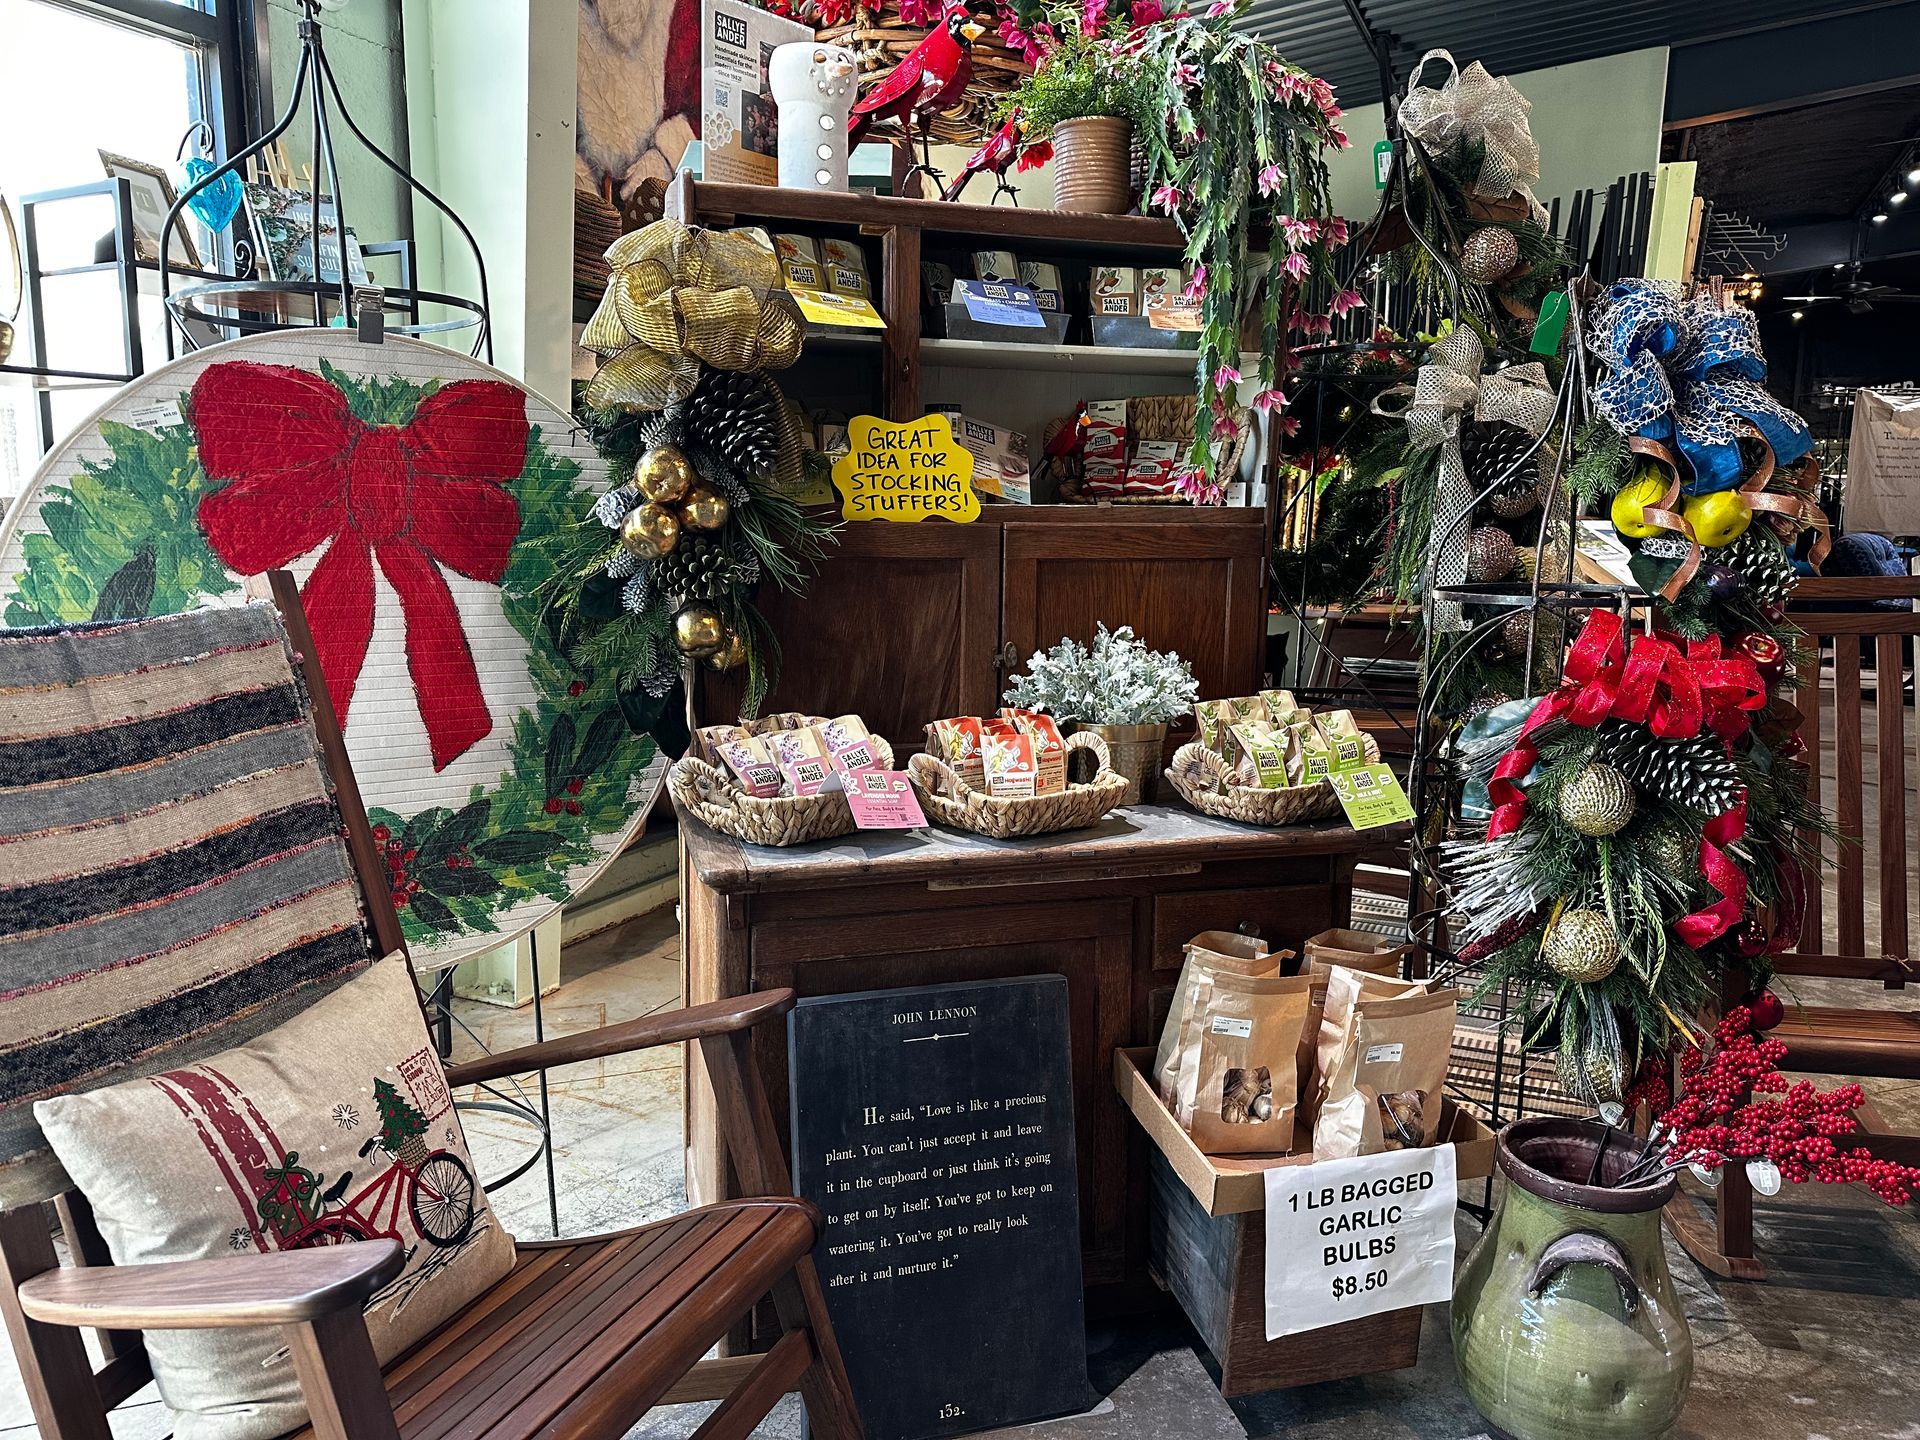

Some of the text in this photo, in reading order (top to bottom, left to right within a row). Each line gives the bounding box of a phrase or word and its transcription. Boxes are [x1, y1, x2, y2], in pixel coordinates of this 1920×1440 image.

[717, 15, 745, 34] SALLYE
[717, 27, 745, 47] ANDER
[790, 267, 814, 277] SALLYE
[836, 270, 861, 281] SALLYE
[792, 275, 816, 284] ANDER
[837, 279, 861, 289] ANDER
[1104, 304, 1128, 313] ANDER
[967, 423, 993, 435] SALLYE
[867, 426, 941, 450] GREAT
[967, 430, 994, 443] ANDER
[857, 452, 900, 470] IDEA
[909, 452, 947, 469] FOR
[850, 473, 962, 493] STOCKING
[851, 493, 969, 513] STUFFERS!
[1338, 743, 1357, 753] SALLYE
[841, 748, 867, 763] SALLYE
[1259, 752, 1277, 760] SALLYE
[1340, 751, 1359, 760] ANDER
[846, 755, 871, 770] ANDER
[1260, 759, 1280, 768] ANDER
[1309, 758, 1328, 767] SALLYE
[749, 768, 773, 778] SALLYE
[797, 764, 820, 775] SALLYE
[1310, 766, 1329, 775] ANDER
[754, 774, 778, 785] ANDER
[800, 772, 825, 783] ANDER
[864, 775, 884, 783] SALLYE
[1352, 773, 1370, 781] SALLYE
[867, 782, 888, 790] ANDER
[1356, 779, 1374, 788] ANDER
[892, 1006, 977, 1025] JOHN LENNON
[863, 1094, 1047, 1126] He said, “Love is like a precious
[825, 1123, 1042, 1166] plant. You can’t just accept it and leave
[826, 1153, 1051, 1194] it in the cupboard or just think it’s going
[1288, 1171, 1434, 1213] 1 LB BAGGED
[827, 1182, 1053, 1225] to get on by itself. You’ve got to keep on
[1319, 1205, 1402, 1236] GARLIC
[828, 1214, 1029, 1256] watering it. You’ve got to really look
[1323, 1235, 1396, 1266] BULBS
[829, 1273, 854, 1288] after
[860, 1271, 867, 1282] it
[873, 1266, 892, 1280] and
[898, 1259, 937, 1276] nurture
[1332, 1269, 1388, 1301] $8.50
